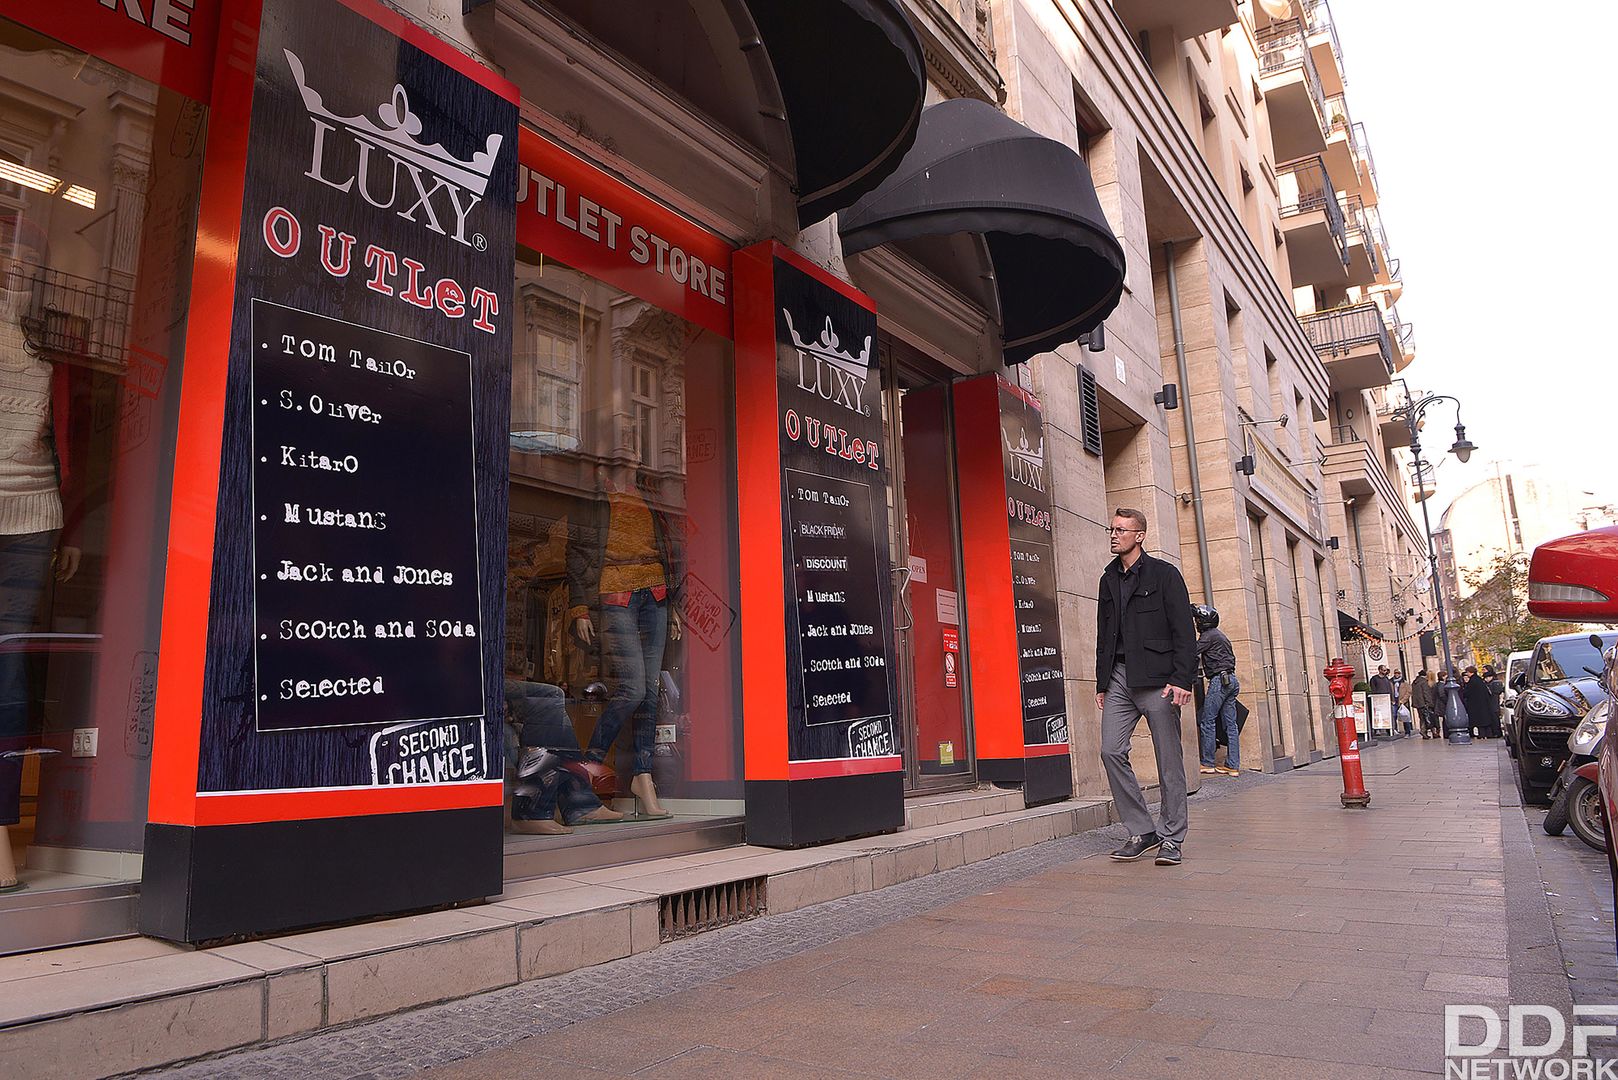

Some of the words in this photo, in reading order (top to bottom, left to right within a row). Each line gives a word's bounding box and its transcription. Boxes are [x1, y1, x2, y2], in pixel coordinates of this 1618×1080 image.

[629, 226, 727, 305] STORE
[801, 523, 823, 536] BLACK
[824, 524, 845, 537] FRIDAY
[277, 560, 334, 583] Jack
[341, 565, 385, 584] and
[392, 565, 453, 586] Jones
[805, 558, 847, 569] DISCOUNT
[279, 620, 367, 640] Scotch
[374, 620, 416, 639] and
[807, 623, 828, 638] Jack
[830, 624, 847, 636] and
[849, 623, 874, 636] Jones
[810, 657, 843, 672] Scotch
[844, 657, 861, 669] and
[279, 676, 385, 700] Selected
[812, 691, 852, 708] Selected
[399, 724, 460, 757] SECOND
[858, 720, 883, 741] SECOND
[855, 732, 891, 758] CHANCE
[387, 743, 477, 785] CHANCE
